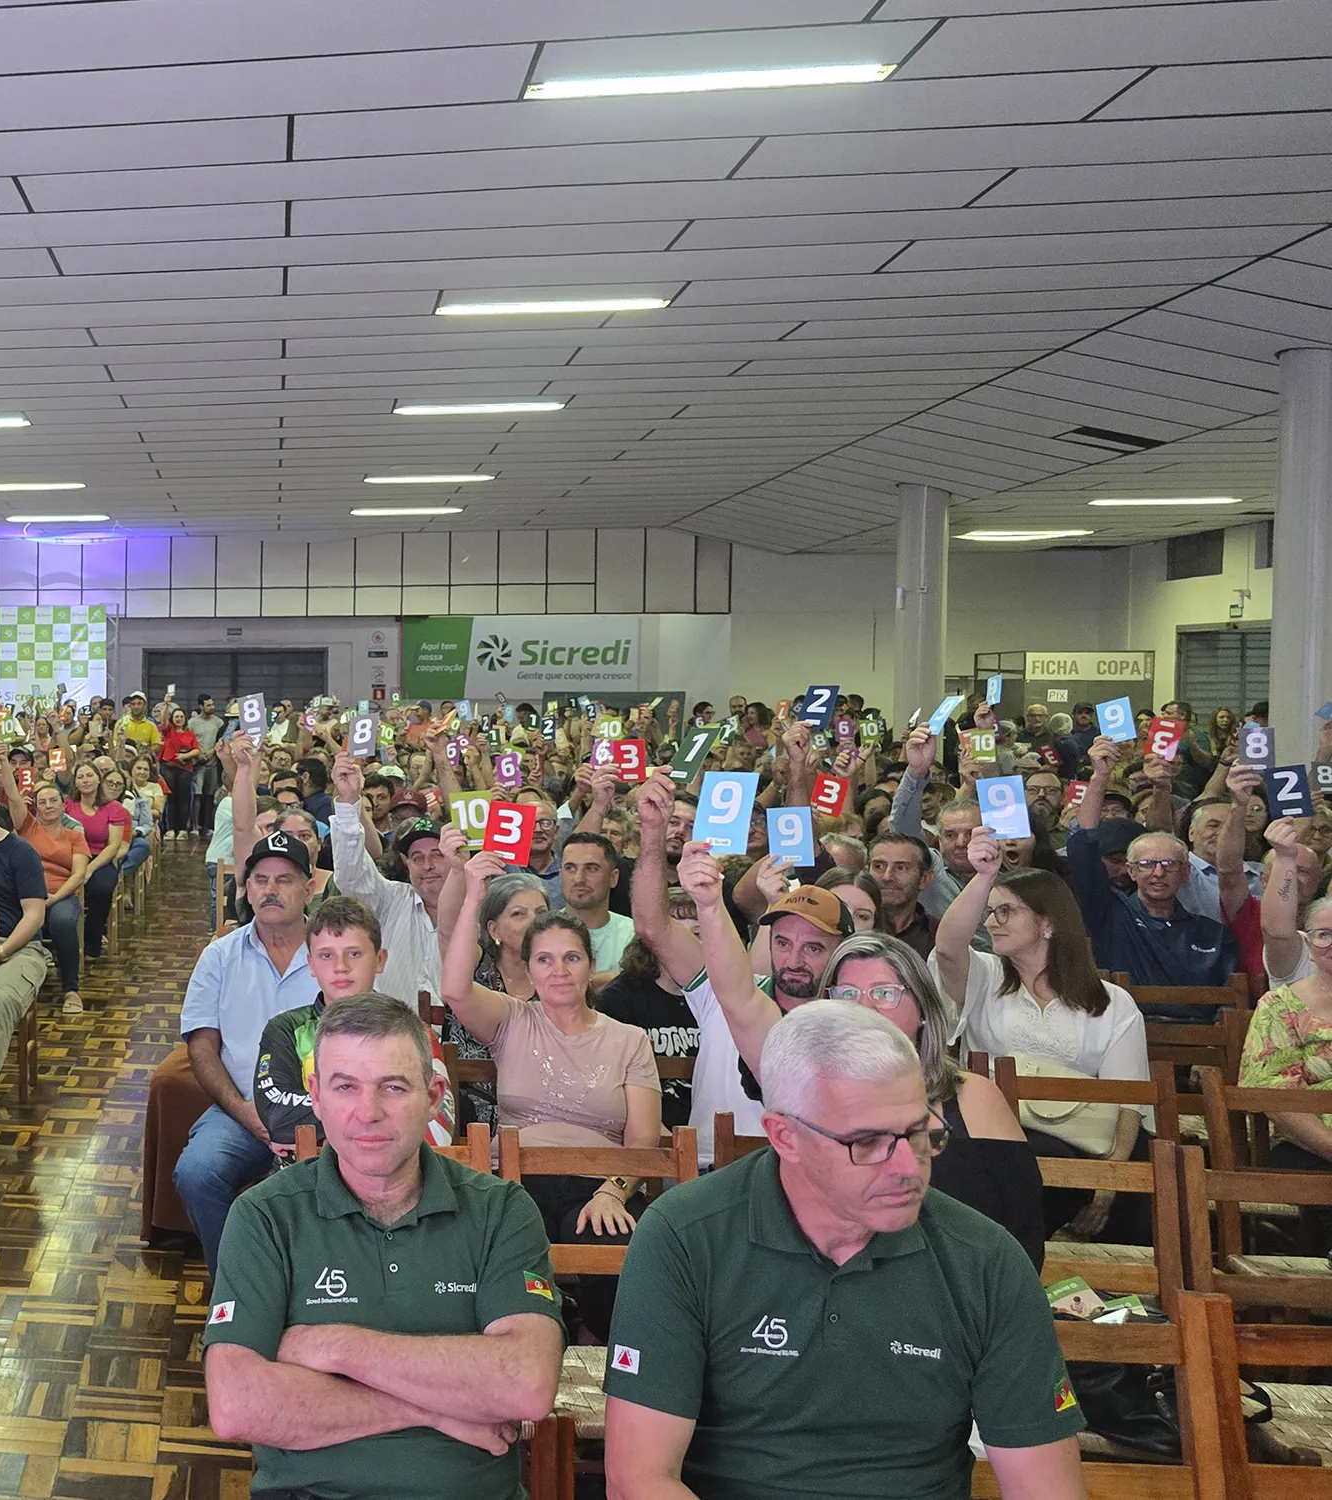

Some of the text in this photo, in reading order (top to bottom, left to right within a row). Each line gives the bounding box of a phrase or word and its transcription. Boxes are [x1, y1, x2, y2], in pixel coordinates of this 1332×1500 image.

[421, 642, 458, 652] Aqui tem
[519, 639, 632, 667] Sicredi
[416, 664, 463, 674] cooperação
[1031, 660, 1079, 675] FICHA
[1096, 660, 1142, 675] COPA
[517, 671, 544, 680] Gente
[545, 673, 562, 682] que
[564, 673, 600, 682] coopera
[806, 689, 831, 713] 2
[1048, 690, 1066, 700] PIX
[243, 700, 261, 723] 8
[459, 703, 468, 714] 9
[934, 702, 952, 720] 9
[1104, 704, 1125, 729] 9
[0, 720, 13, 734] 10
[306, 715, 316, 726] 6
[482, 716, 488, 731] 2
[529, 714, 537, 726] 1
[543, 720, 554, 734] 2
[838, 721, 849, 735] 6
[354, 719, 373, 744] 8
[380, 725, 394, 739] 10
[489, 730, 497, 740] 1
[860, 722, 878, 736] 10
[685, 733, 709, 762] 1
[814, 734, 826, 747] 8
[971, 735, 994, 751] 10
[1246, 732, 1268, 758] 8
[52, 750, 61, 763] 7
[447, 743, 457, 758] 6
[620, 745, 639, 769] 3
[501, 758, 515, 777] 6
[1317, 765, 1332, 783] 8
[22, 770, 31, 785] 3
[1273, 771, 1303, 801] 2
[818, 779, 841, 804] 3
[1071, 785, 1087, 804] 3
[708, 781, 743, 824] 9
[987, 783, 1016, 819] 9
[452, 798, 490, 830] 10
[493, 809, 523, 844] 3
[777, 813, 803, 846] 9
[314, 1266, 347, 1297] 45
[447, 1282, 477, 1293] Sicredi
[752, 1314, 788, 1349] 45
[903, 1343, 941, 1360] Sicredi
